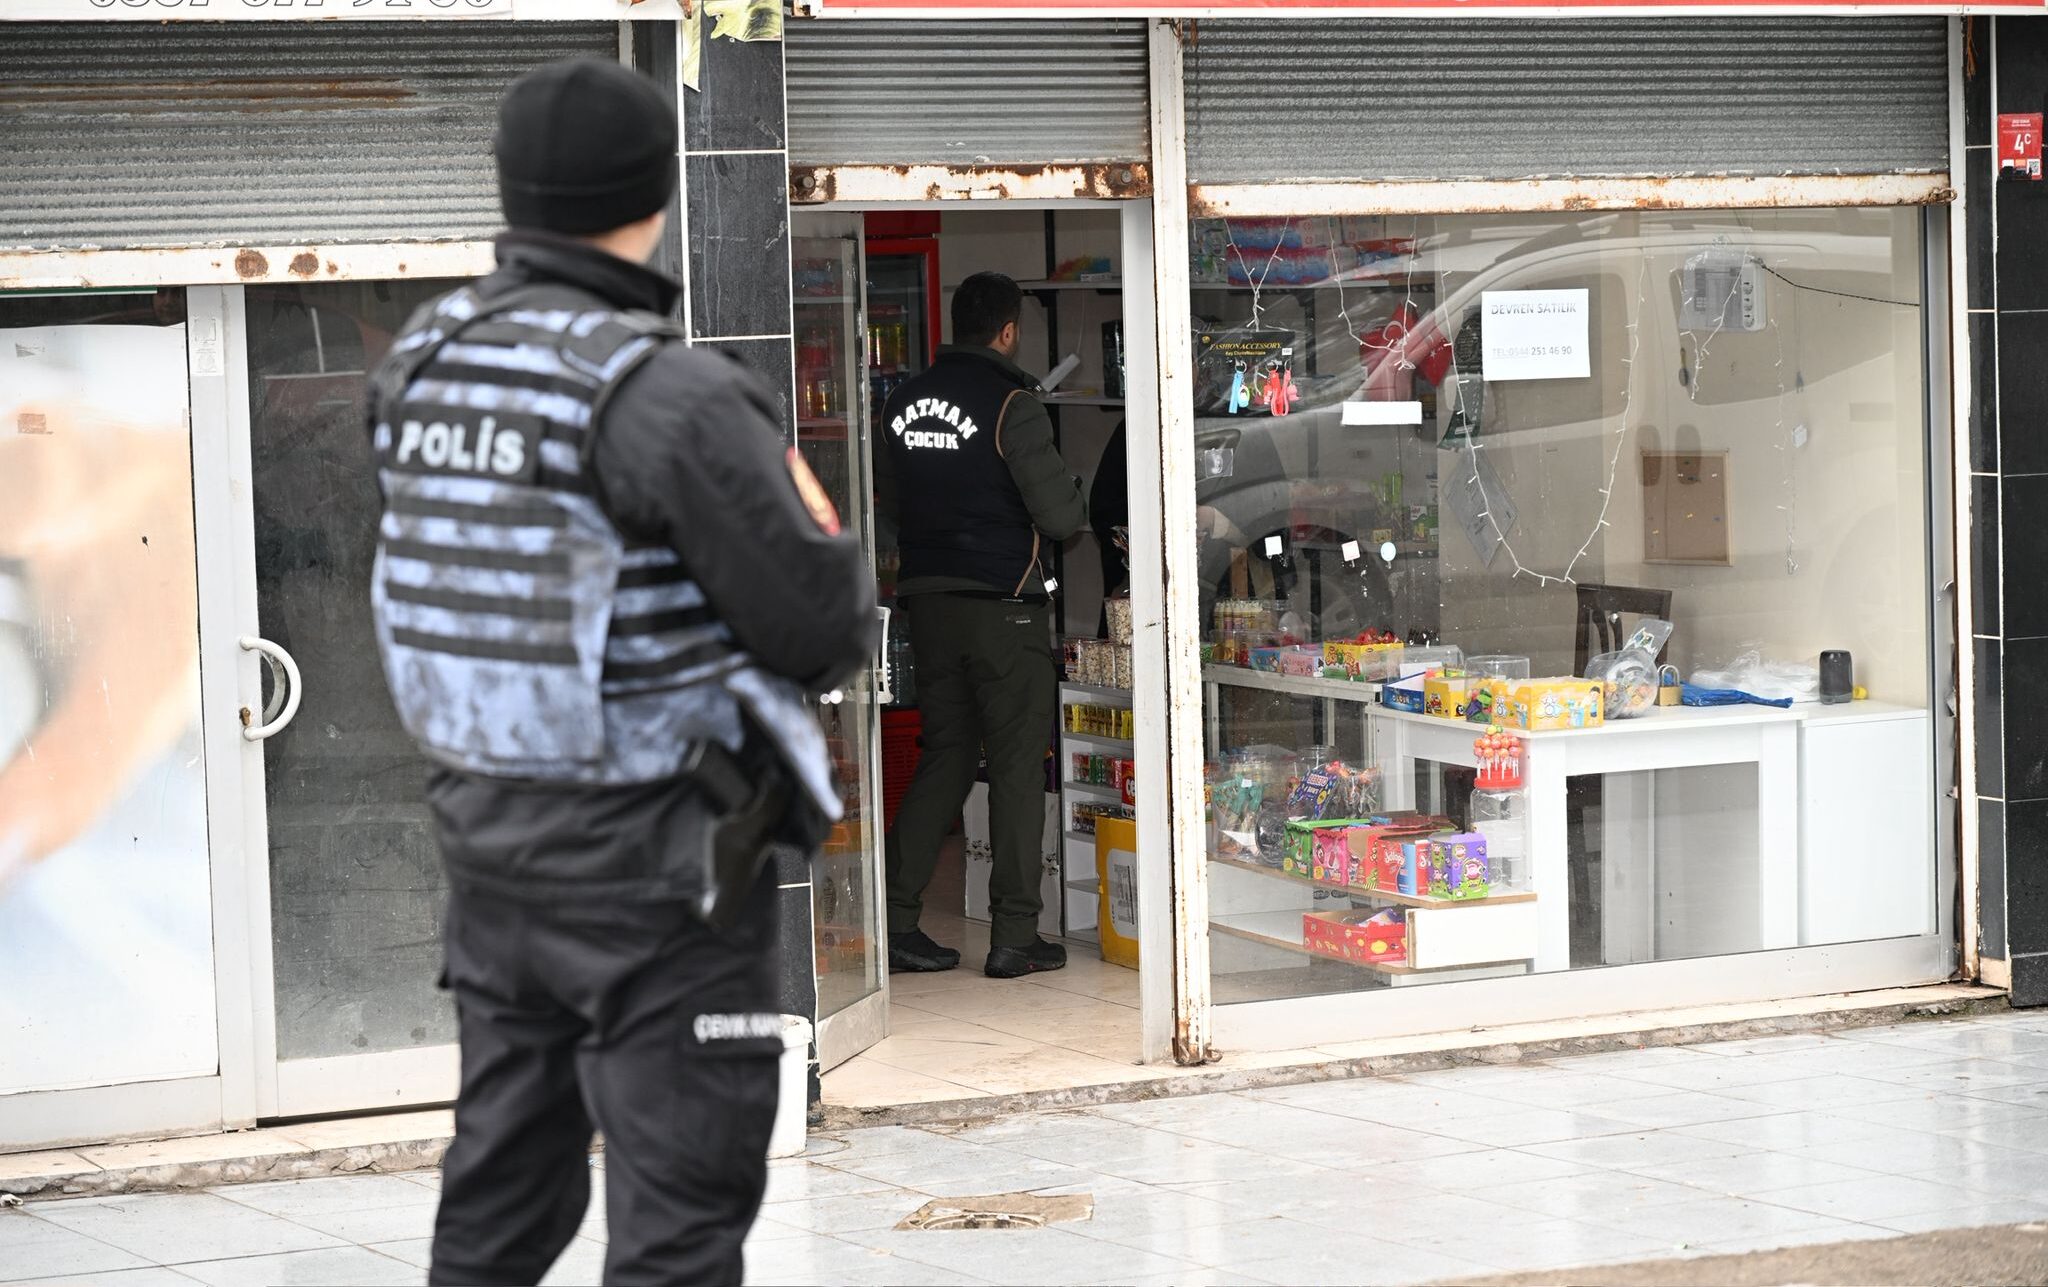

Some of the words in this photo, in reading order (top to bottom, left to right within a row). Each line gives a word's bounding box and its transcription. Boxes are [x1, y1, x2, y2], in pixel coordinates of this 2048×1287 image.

[1531, 346, 1547, 356] 251
[1561, 345, 1573, 355] 90
[891, 398, 978, 440] BATMAN
[904, 431, 959, 450] ÇOCUK
